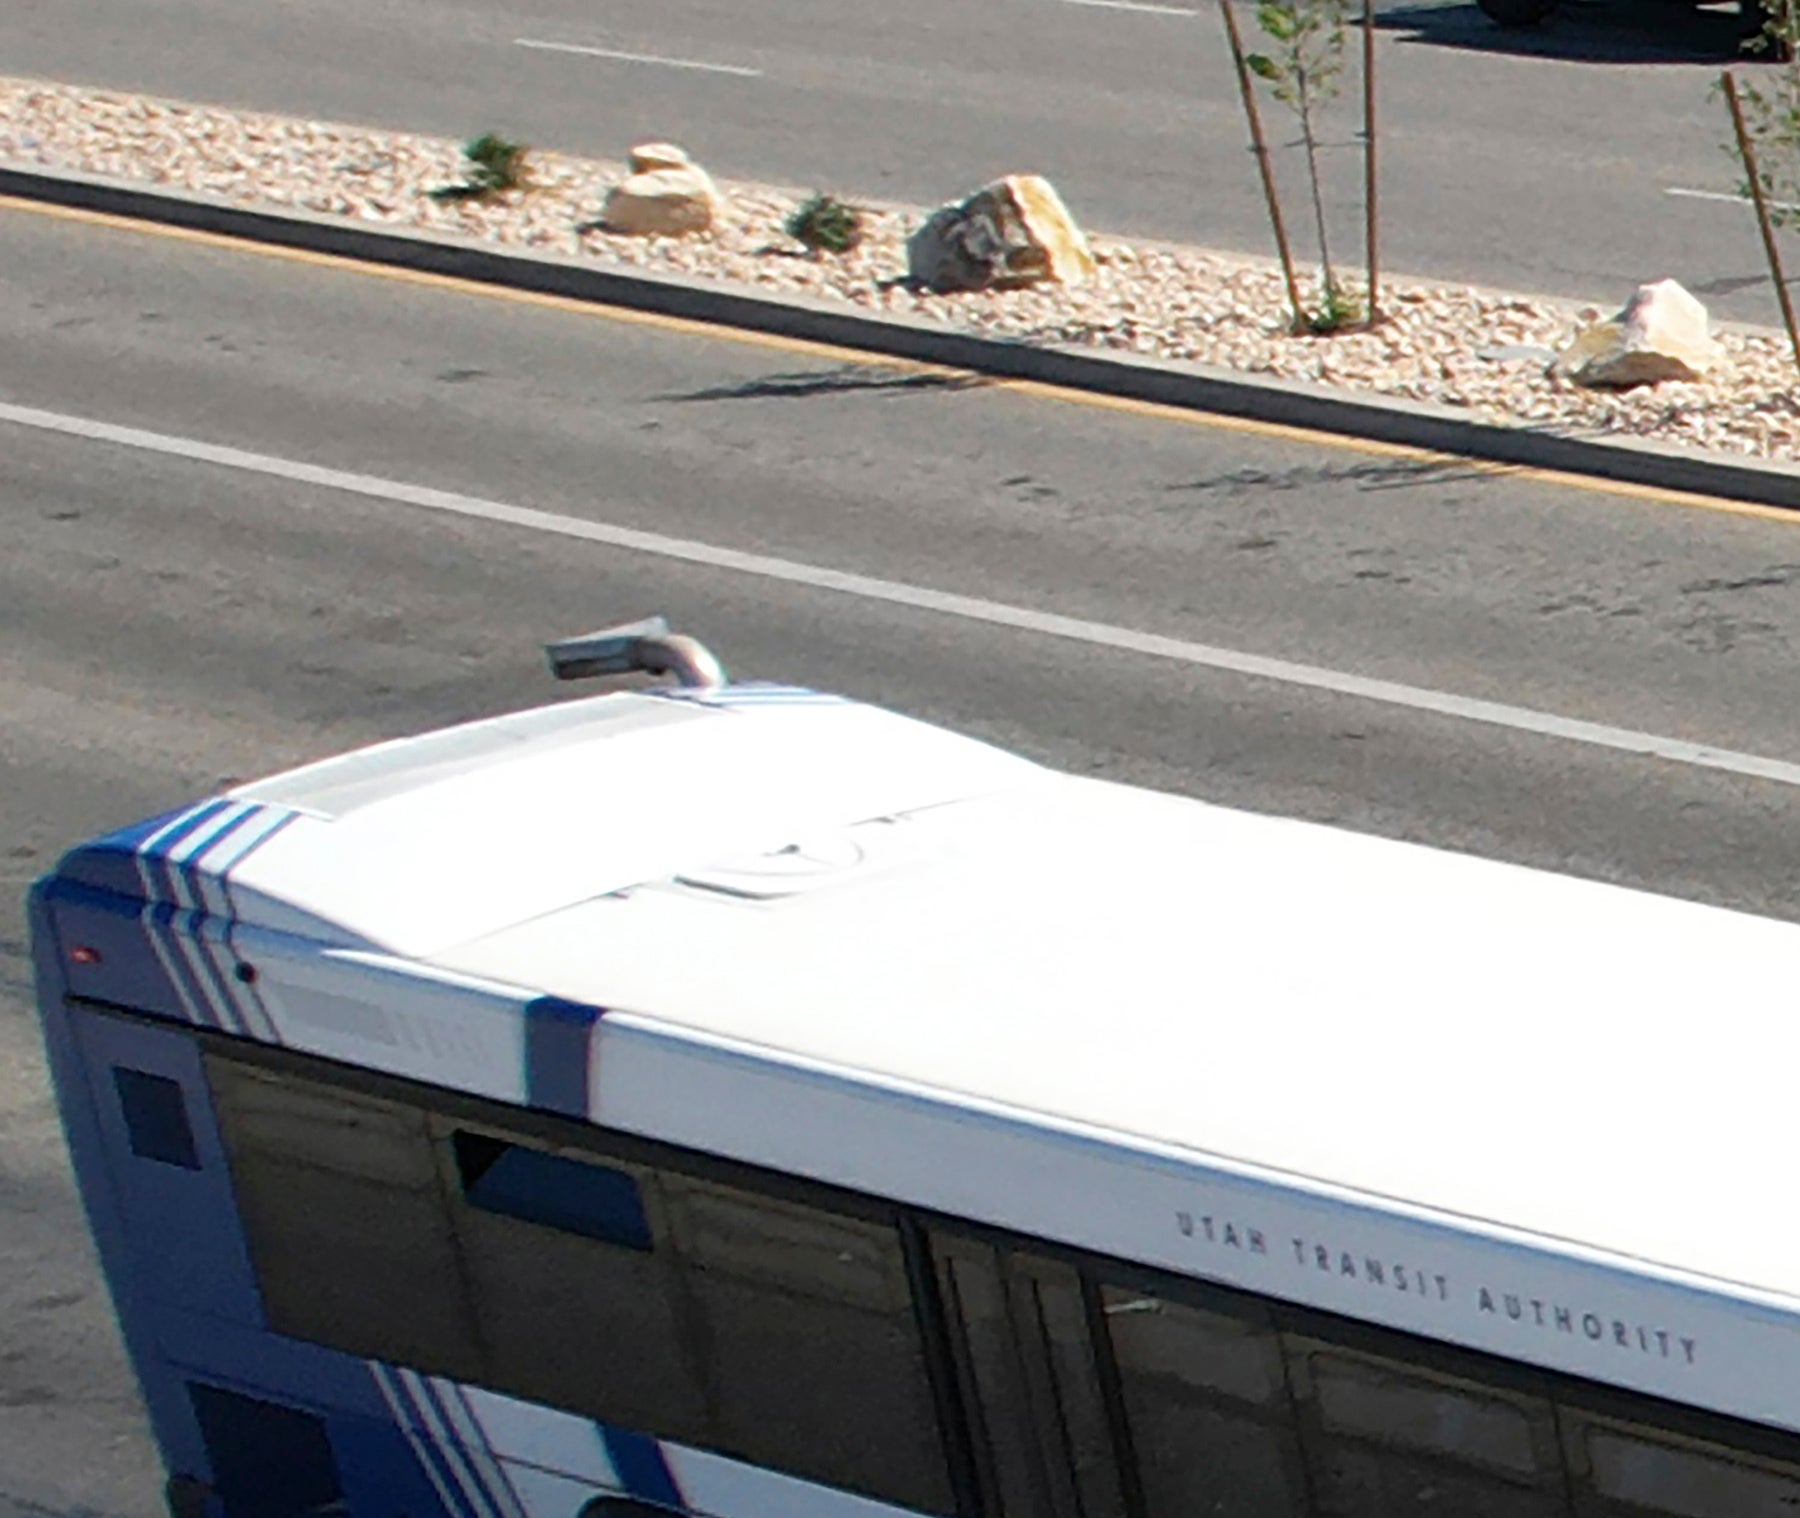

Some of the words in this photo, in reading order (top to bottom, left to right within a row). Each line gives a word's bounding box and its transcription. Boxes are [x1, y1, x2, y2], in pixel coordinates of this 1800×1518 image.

[1175, 1210, 1267, 1256] UTAH
[1292, 1236, 1446, 1301] TRANSIT
[1478, 1286, 1695, 1364] AUTHORITY
